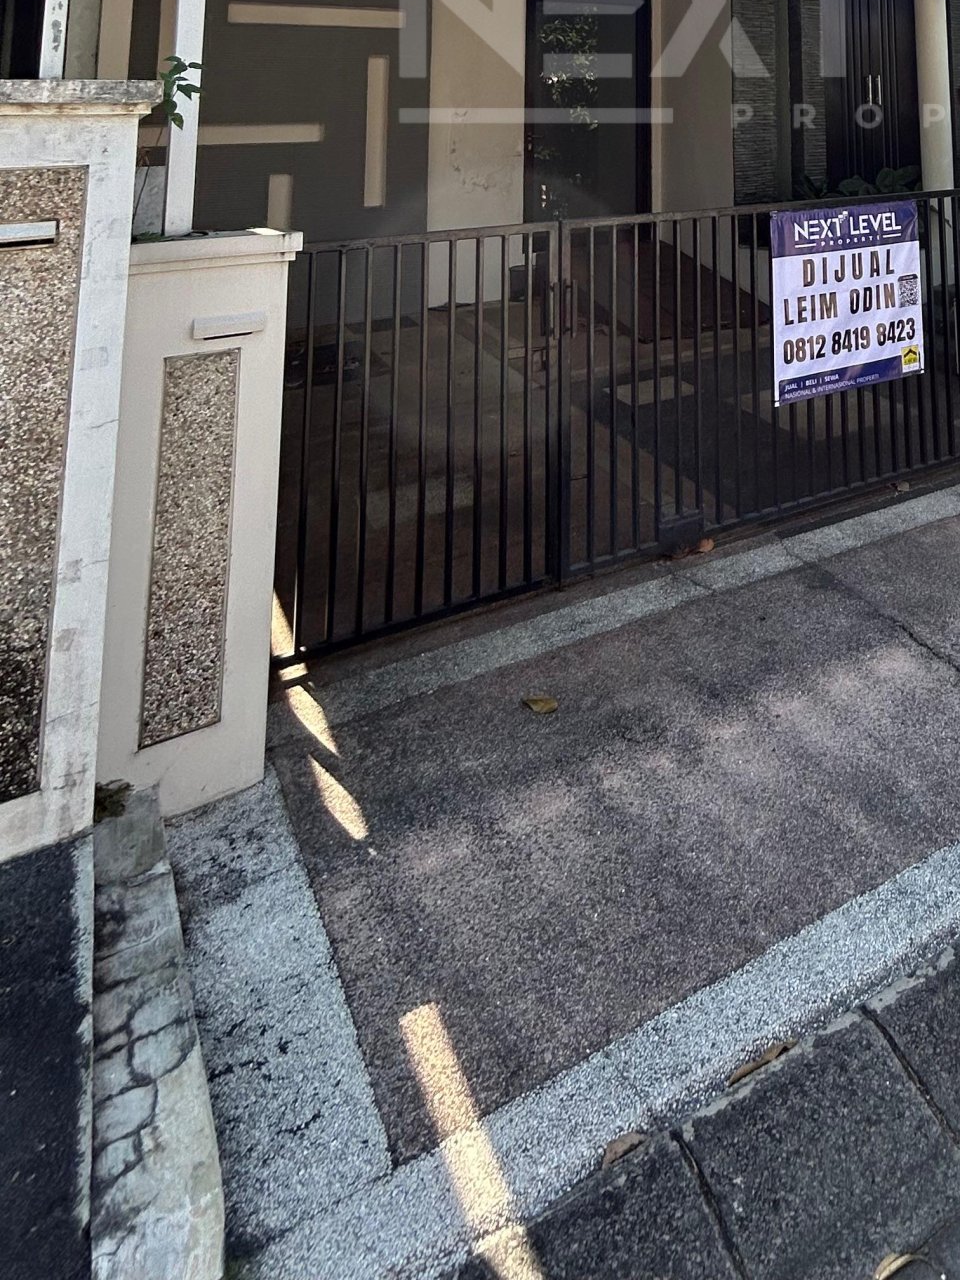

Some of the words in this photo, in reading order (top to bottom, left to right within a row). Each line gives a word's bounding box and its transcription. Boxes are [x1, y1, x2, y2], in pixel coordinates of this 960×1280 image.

[793, 216, 846, 242] NEXT
[849, 211, 902, 235] LEVEL
[820, 234, 880, 247] PROPERTI
[802, 248, 896, 288] DIJUAL
[783, 291, 839, 326] LEIM
[849, 282, 896, 315] ODIN
[783, 334, 826, 365] 0812
[831, 325, 871, 356] 8419
[876, 317, 916, 347] 8423
[784, 382, 798, 392] JUAL
[805, 378, 817, 387] BELI
